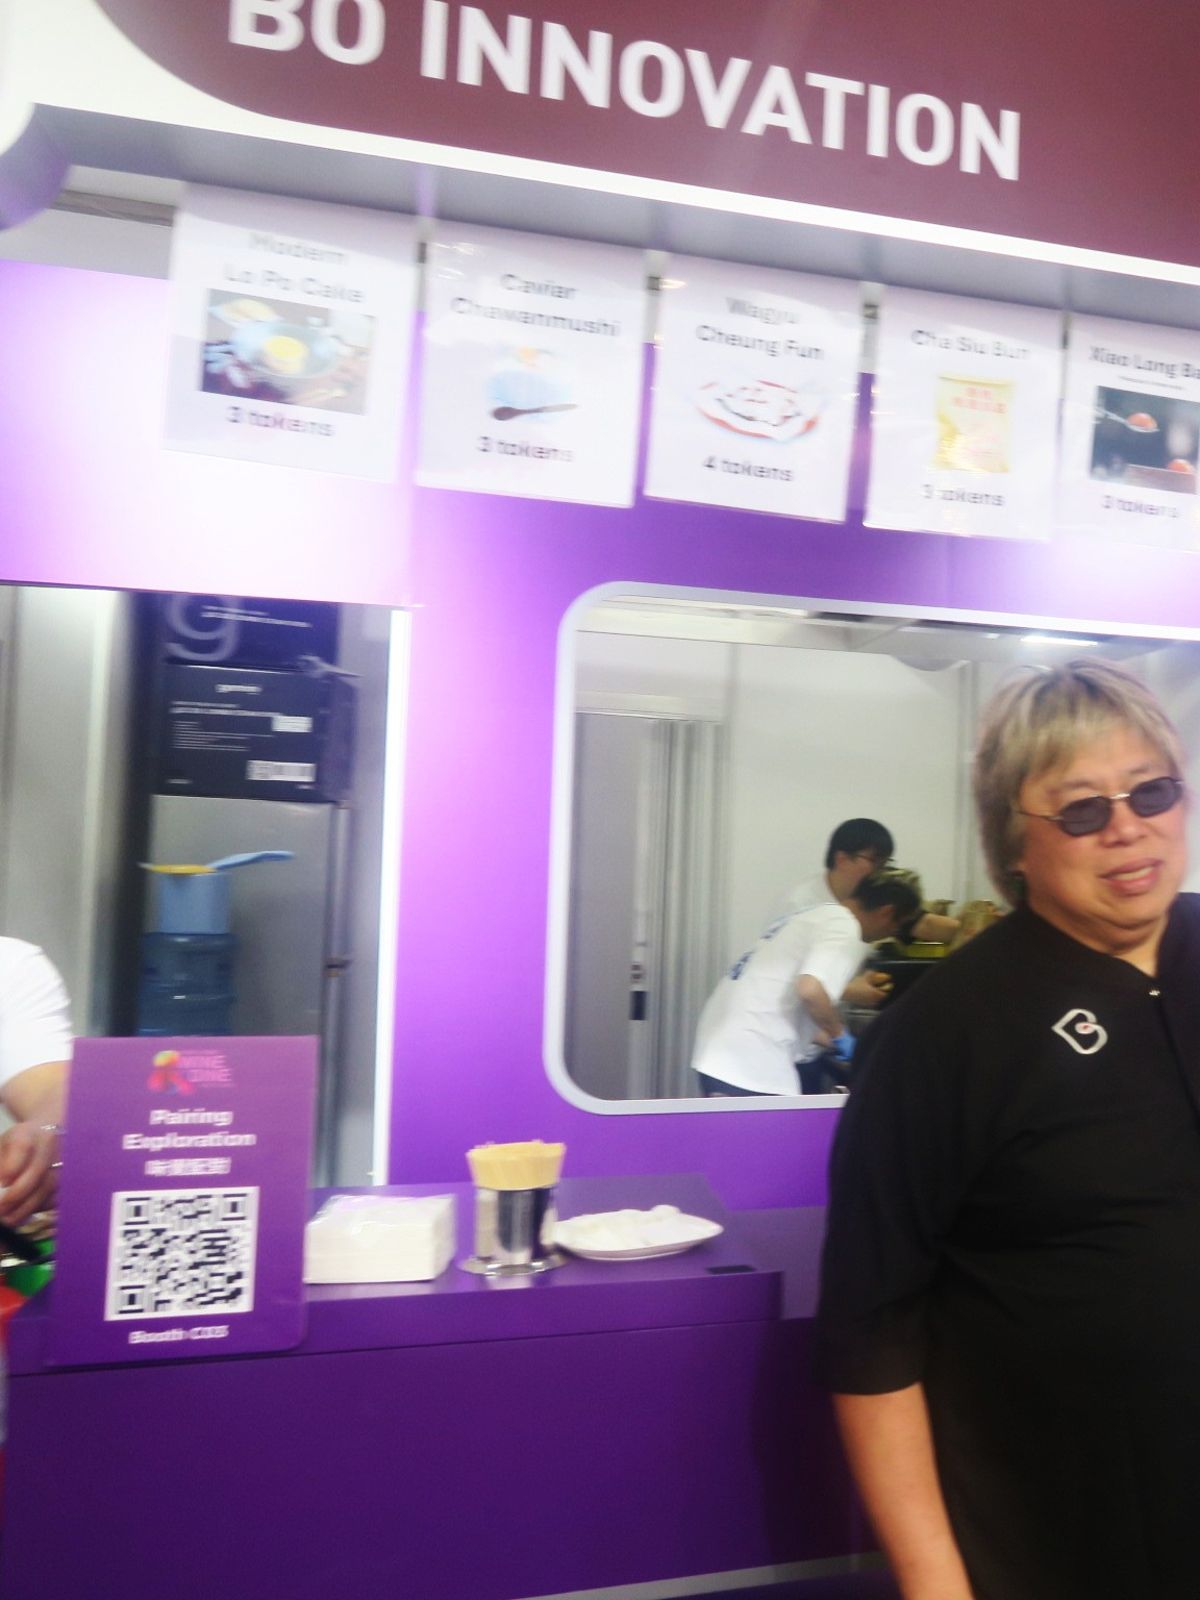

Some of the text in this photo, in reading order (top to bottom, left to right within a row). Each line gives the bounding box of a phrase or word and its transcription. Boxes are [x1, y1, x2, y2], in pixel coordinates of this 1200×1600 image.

[228, 0, 1021, 181] BO INNOVATION
[303, 276, 366, 303] Cake
[501, 273, 577, 300] Caviar
[450, 297, 621, 336] Chawanmushi
[725, 297, 800, 325] Wagyu
[696, 324, 825, 360] Cheung Fun
[911, 329, 1030, 359] Cha Siu Bun
[1089, 345, 1129, 367] Xiao
[1134, 354, 1177, 379] Long
[227, 405, 335, 437] 3 tokens
[477, 435, 575, 463] 3 tokens
[702, 455, 795, 482] 4 tokens
[939, 485, 1006, 507] tokens
[1116, 496, 1180, 518] tokens
[149, 1108, 234, 1126] Pairing
[122, 1131, 257, 1151] Exploration
